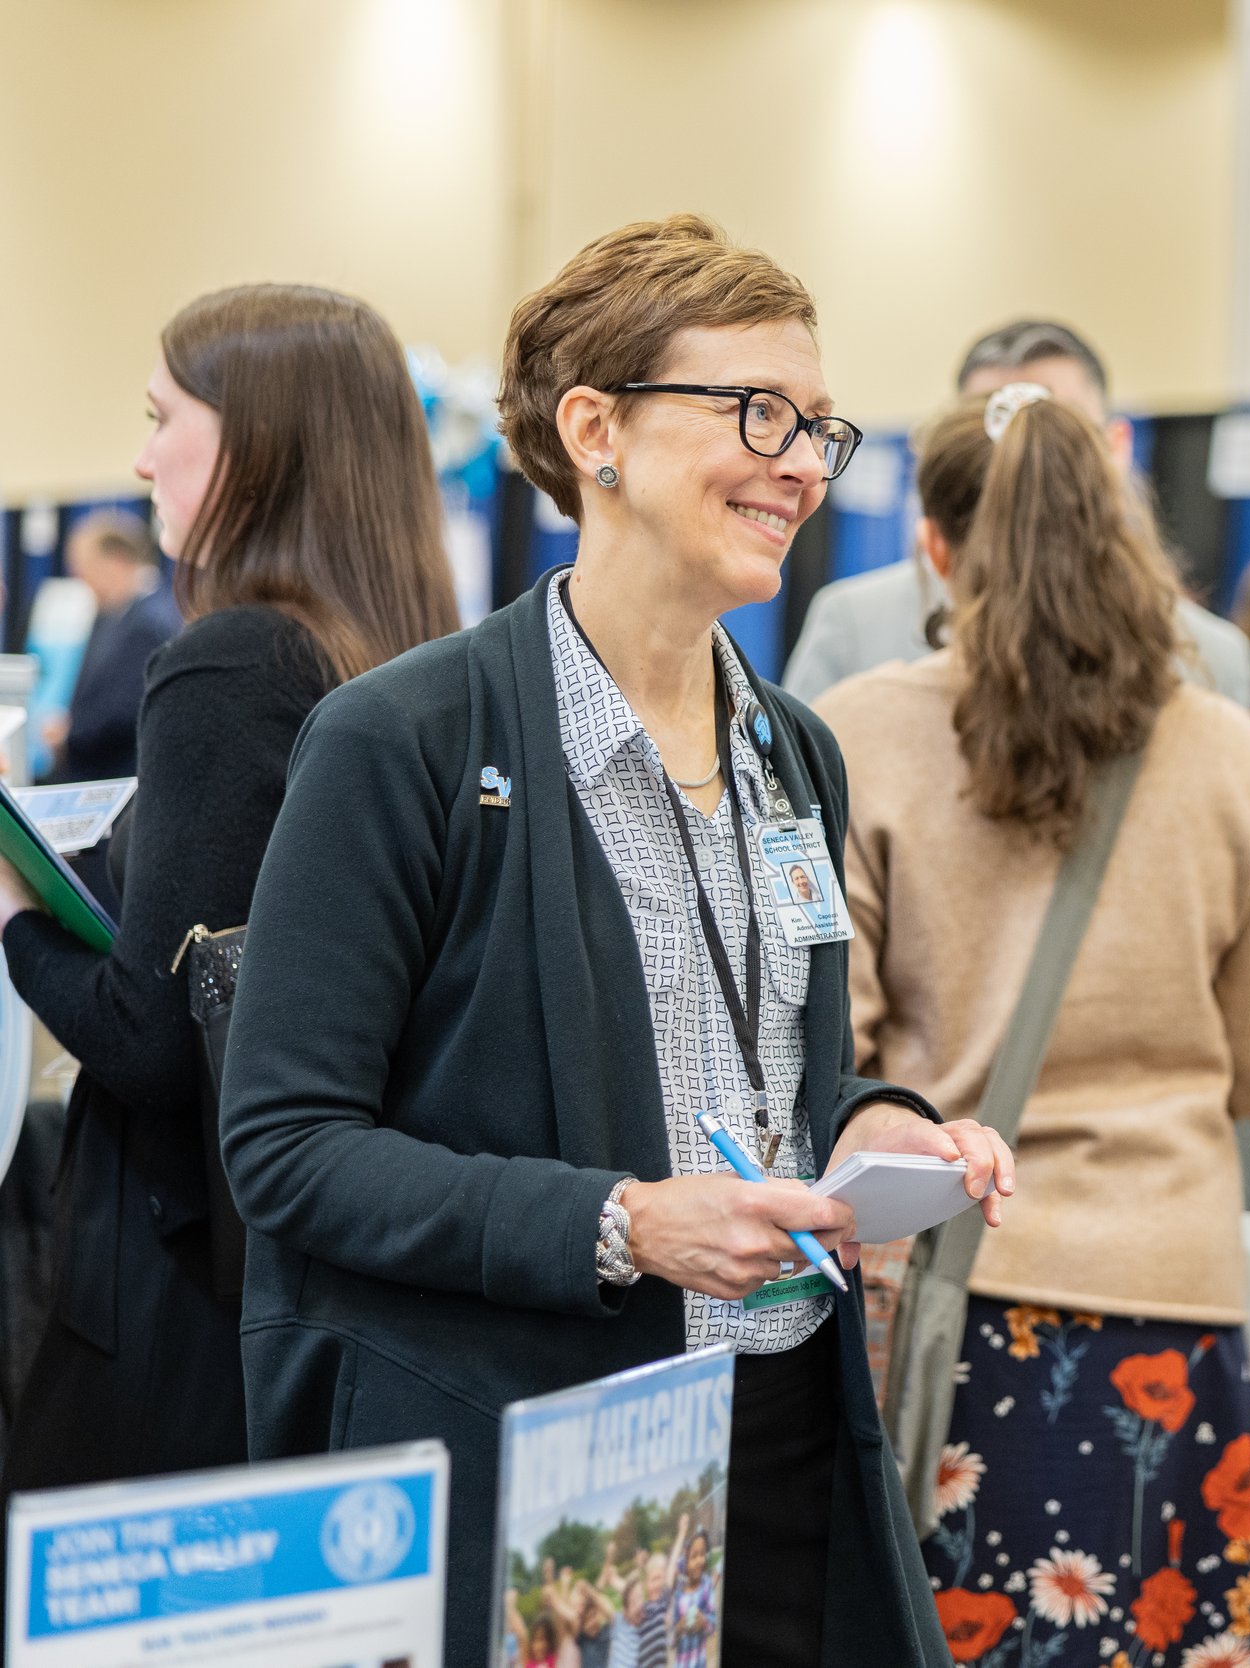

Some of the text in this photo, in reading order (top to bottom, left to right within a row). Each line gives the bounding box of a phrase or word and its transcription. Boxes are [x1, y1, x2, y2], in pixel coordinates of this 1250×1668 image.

[762, 832, 814, 845] SENECA VALLEY
[764, 841, 821, 854] SCHOOL DISTRICT
[794, 930, 848, 943] ADMINISTRATION
[755, 1288, 771, 1300] PERC
[772, 1285, 799, 1297] Education
[511, 1371, 733, 1520] NEW HEIGHTS
